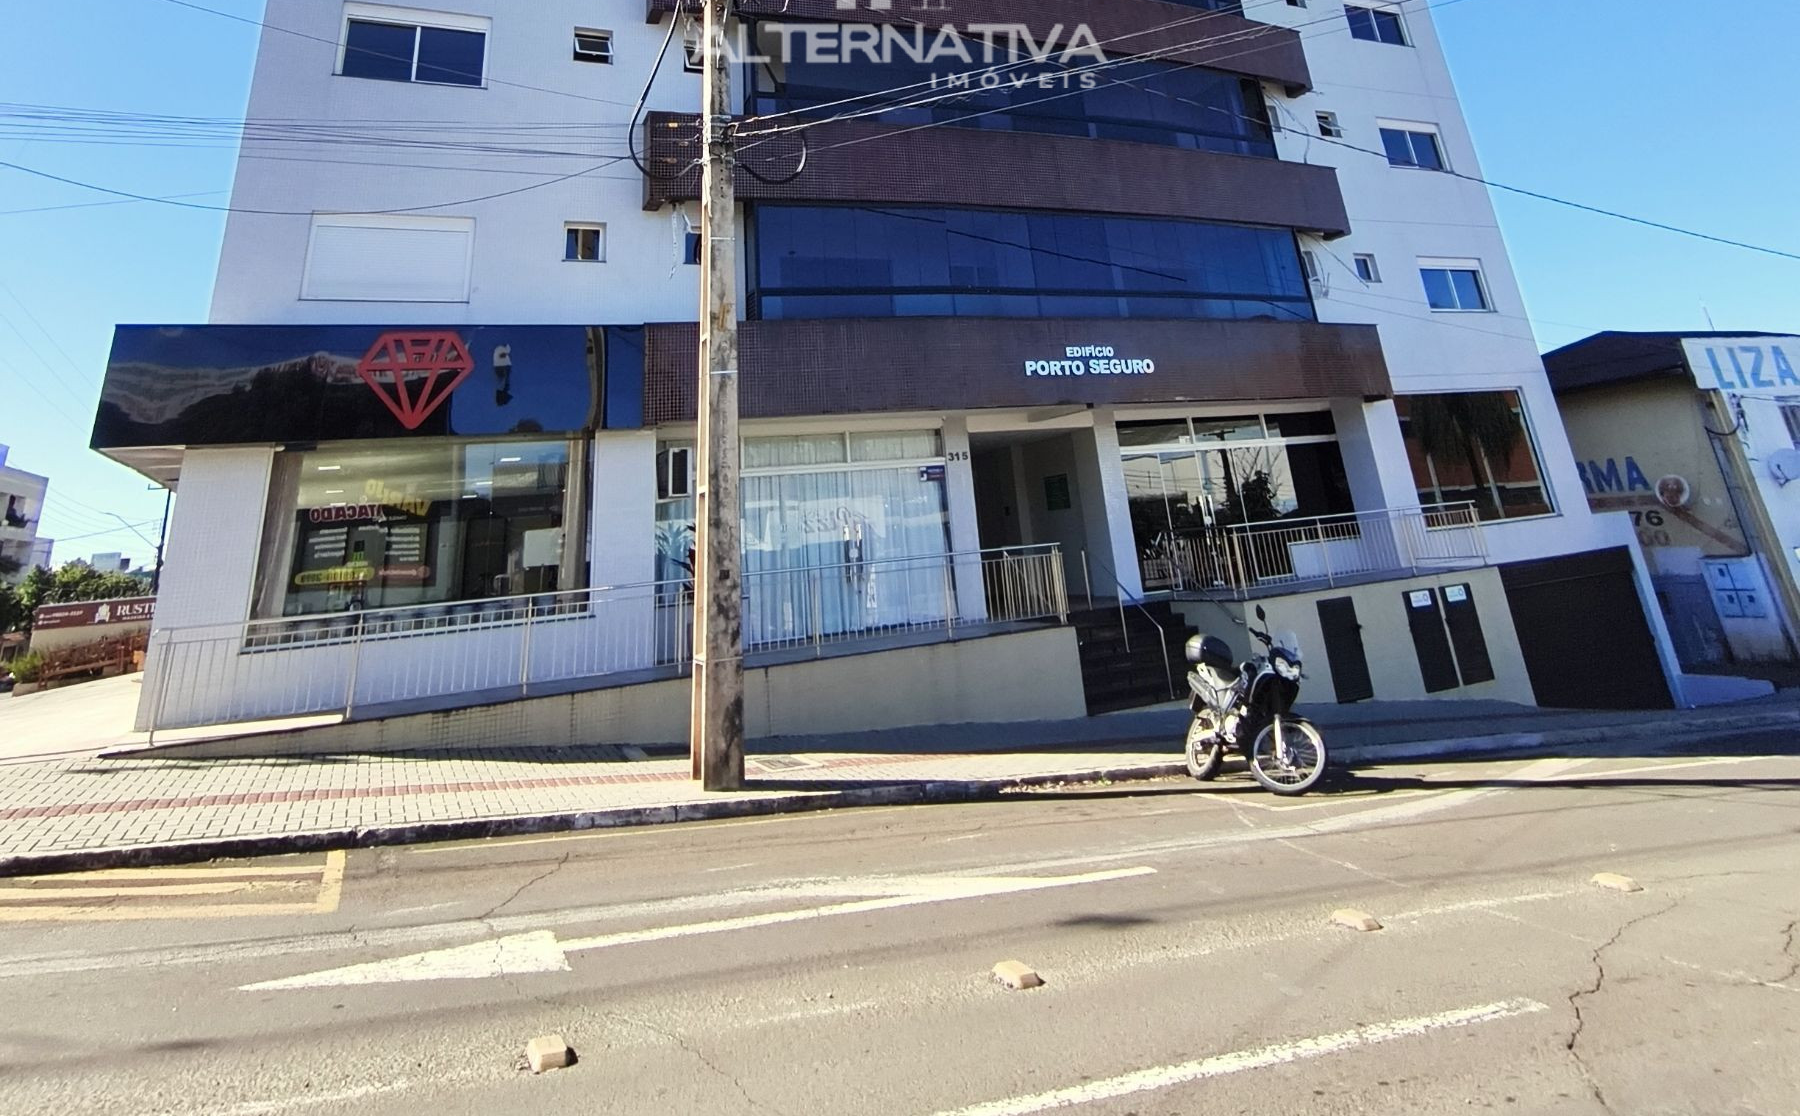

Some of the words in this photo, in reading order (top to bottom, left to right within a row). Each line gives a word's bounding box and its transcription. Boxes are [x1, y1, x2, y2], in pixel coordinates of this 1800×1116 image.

[1065, 345, 1114, 358] EDIFÍCIO
[1025, 360, 1085, 376] PORTO
[1089, 359, 1155, 374] SEGURO
[1704, 346, 1800, 389] LIZA
[948, 451, 969, 462] 315
